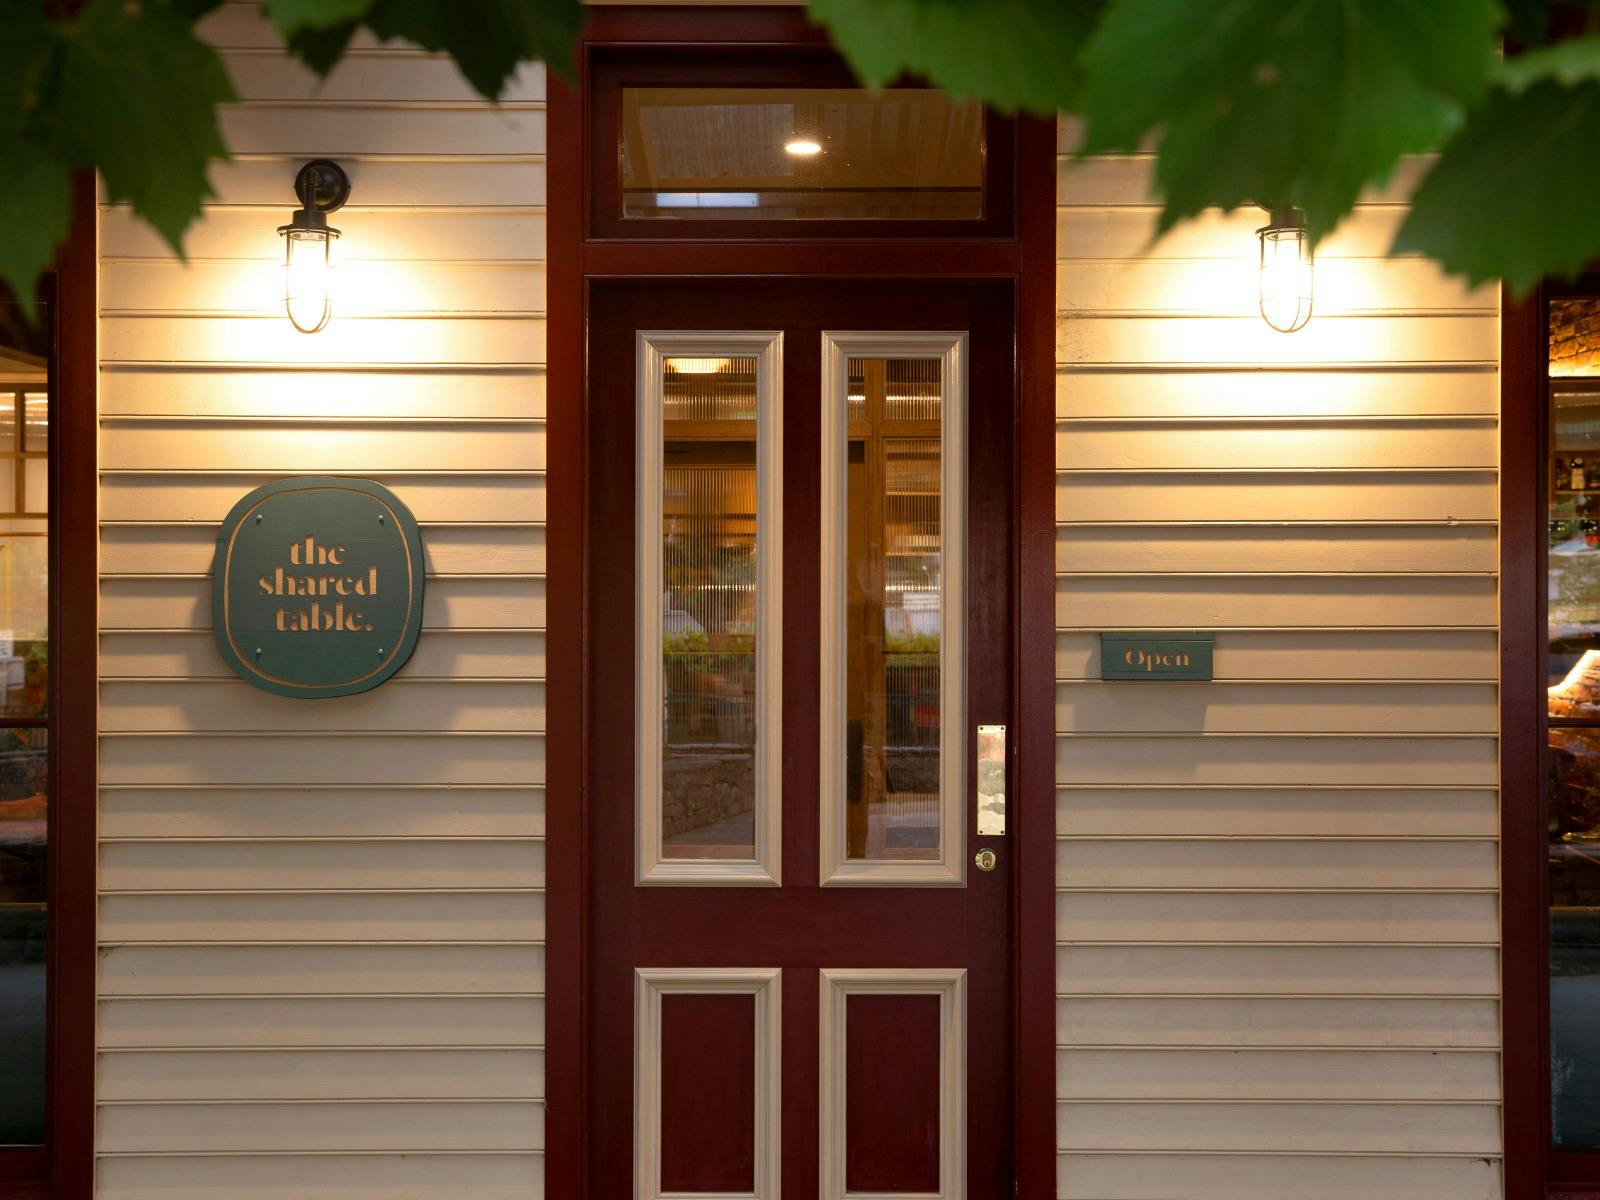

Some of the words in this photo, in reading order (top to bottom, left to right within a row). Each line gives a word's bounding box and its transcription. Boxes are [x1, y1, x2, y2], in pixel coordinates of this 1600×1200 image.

[290, 534, 345, 565] the
[258, 566, 378, 596] shared
[275, 601, 373, 632] table.
[1124, 650, 1190, 672] Open
